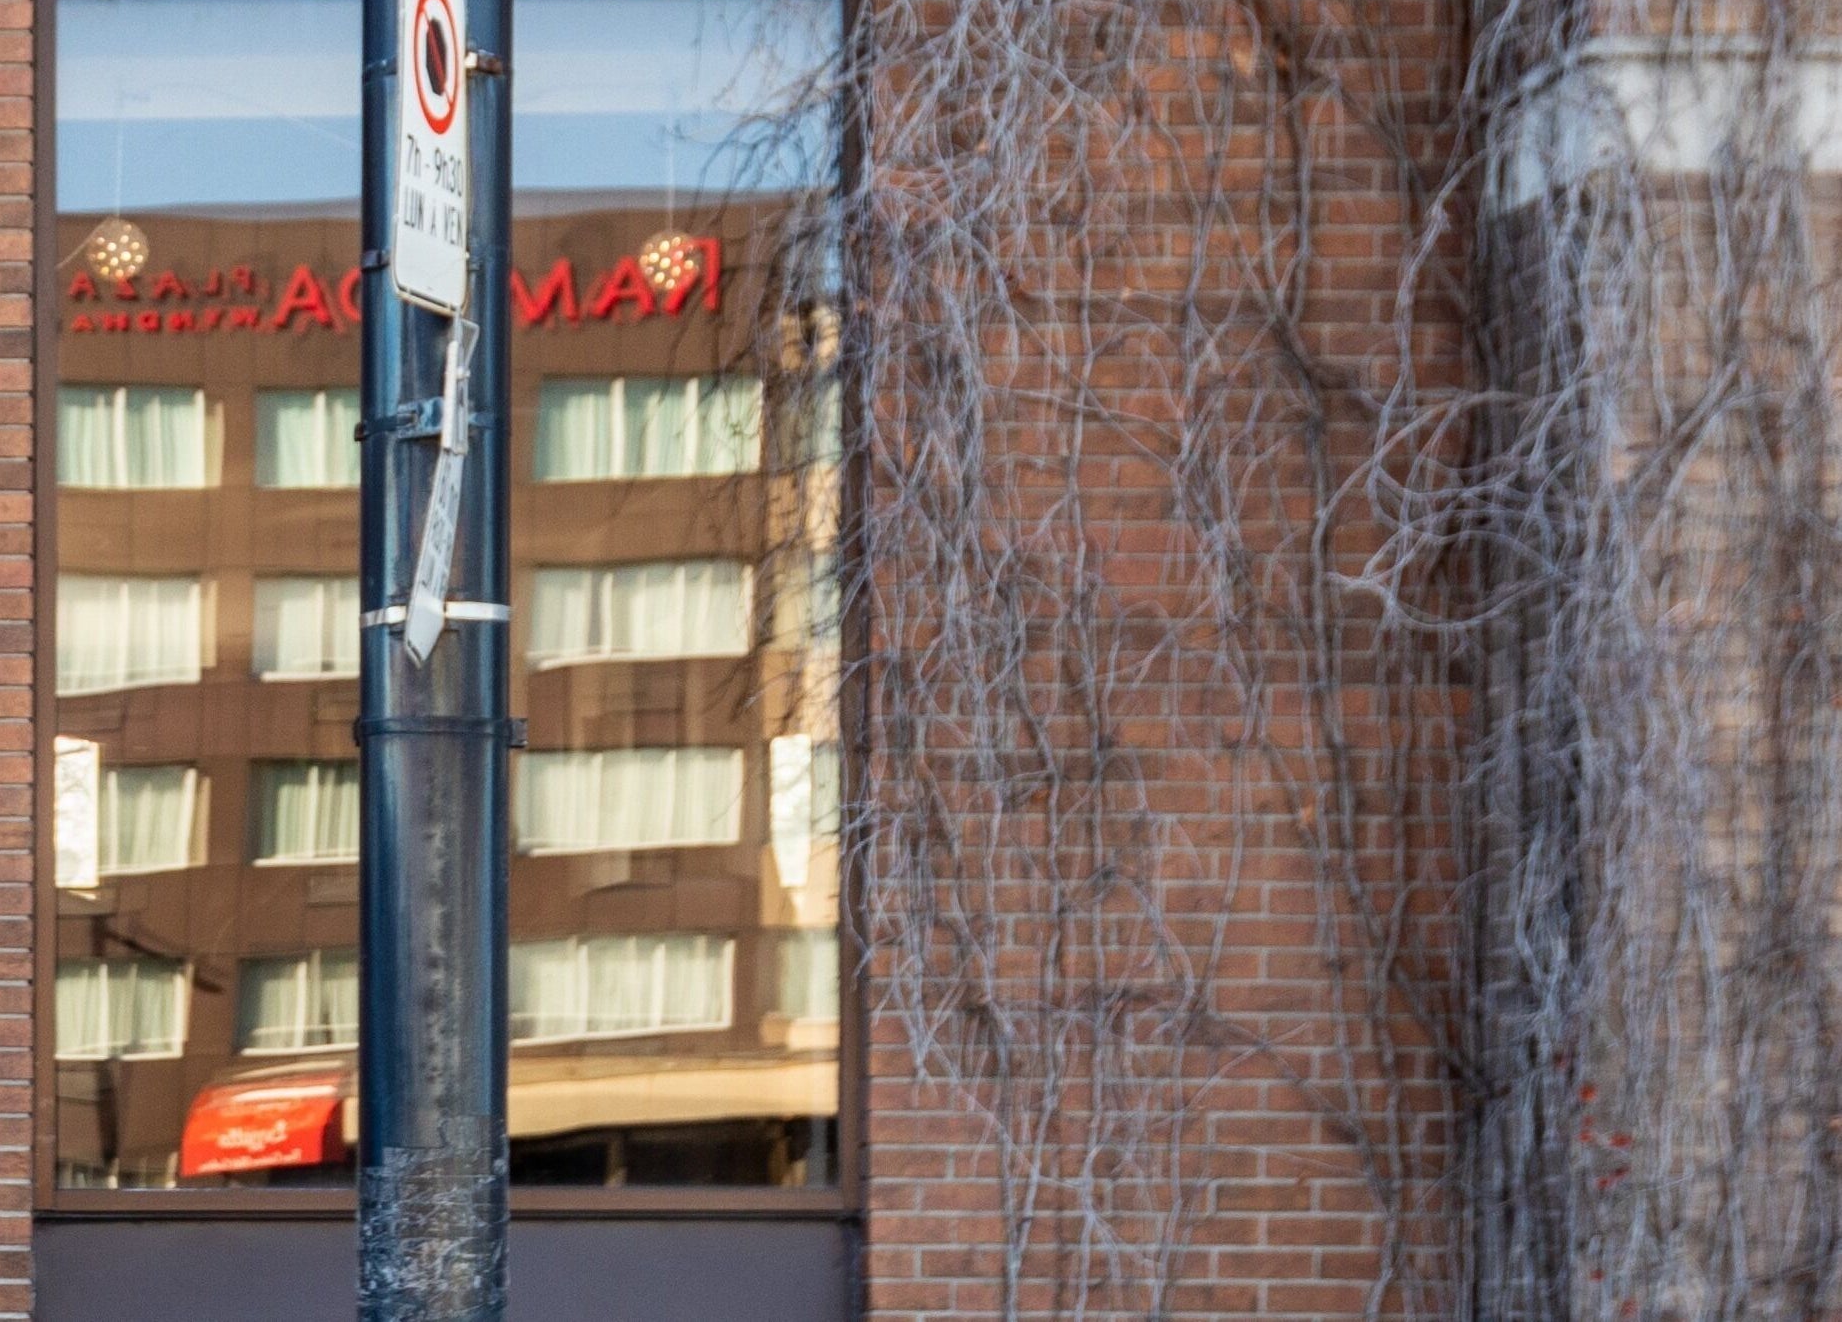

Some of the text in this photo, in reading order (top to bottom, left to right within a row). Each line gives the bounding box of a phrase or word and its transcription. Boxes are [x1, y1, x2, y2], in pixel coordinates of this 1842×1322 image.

[406, 134, 422, 178] 7h
[434, 146, 464, 198] 9h30
[403, 185, 424, 233] LUN
[443, 201, 464, 249] VEN
